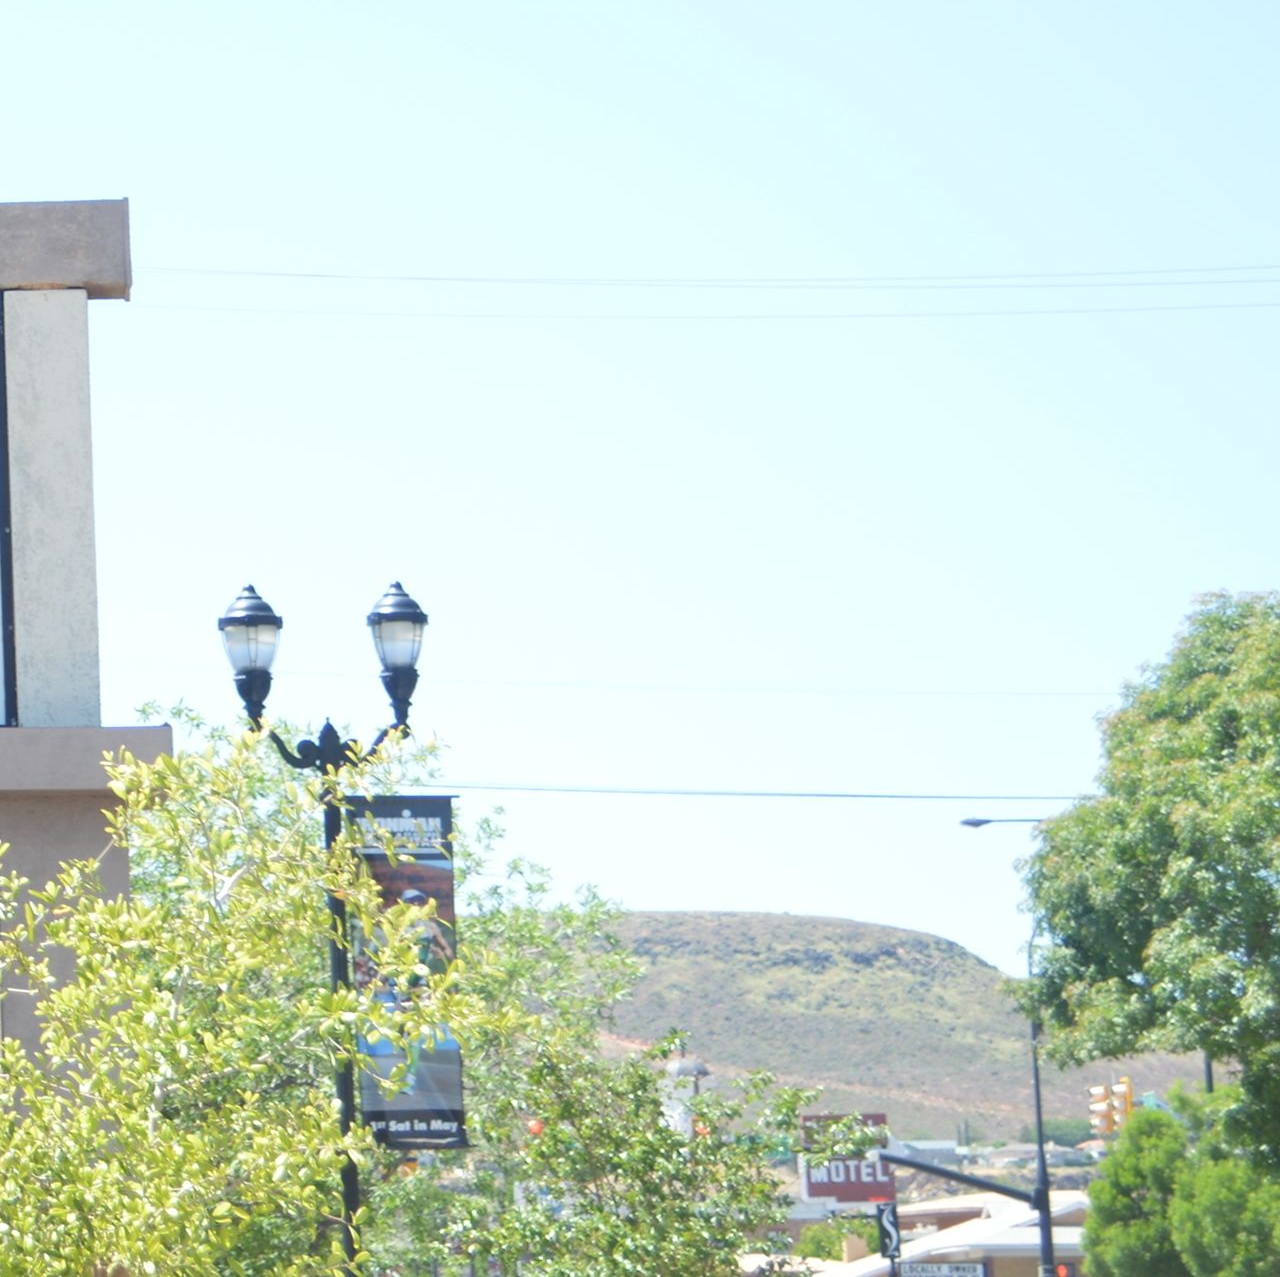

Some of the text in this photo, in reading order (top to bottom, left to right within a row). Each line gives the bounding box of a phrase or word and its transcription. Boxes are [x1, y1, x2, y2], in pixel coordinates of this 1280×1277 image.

[388, 1119, 412, 1132] Sat
[413, 1118, 428, 1132] in
[430, 1118, 458, 1133] May
[810, 1159, 890, 1184] MOTEL
